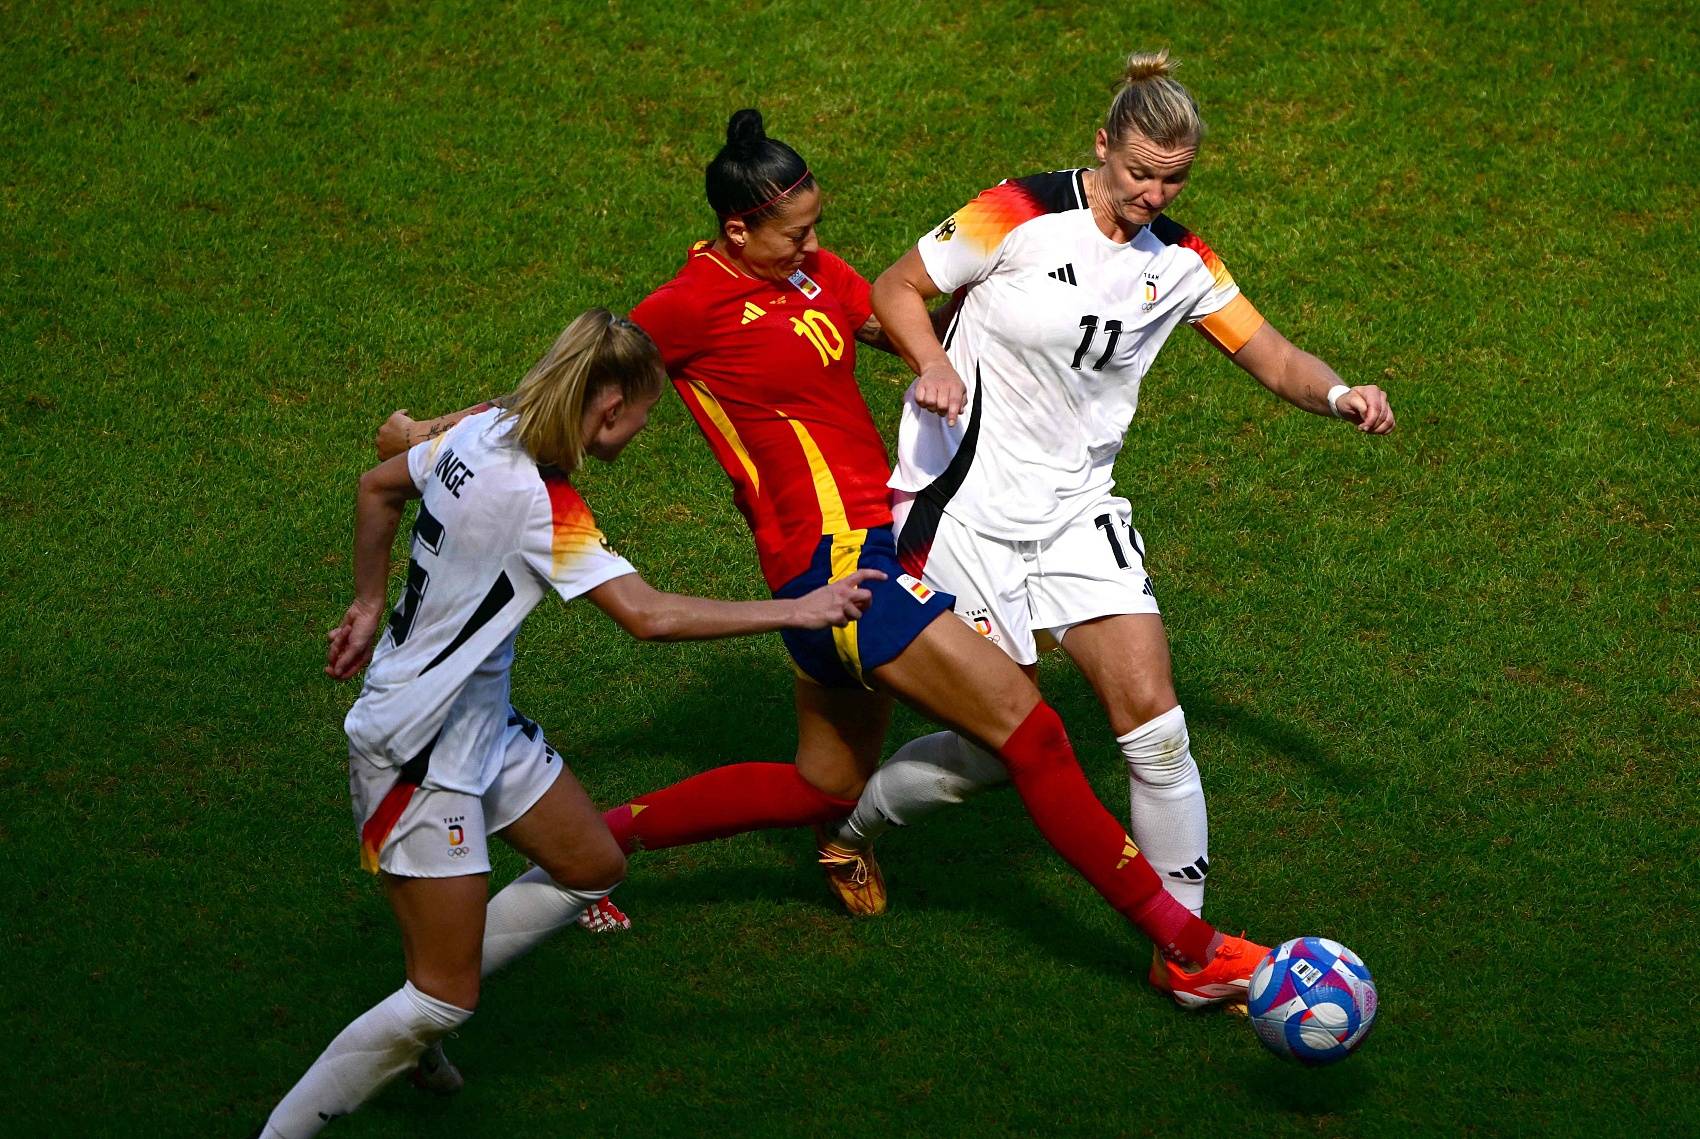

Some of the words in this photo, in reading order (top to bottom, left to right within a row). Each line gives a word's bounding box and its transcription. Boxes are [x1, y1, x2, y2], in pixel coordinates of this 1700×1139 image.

[1144, 272, 1159, 280] TEAM
[789, 309, 844, 367] 10
[1071, 315, 1123, 371] 11
[435, 448, 475, 499] INGE
[966, 608, 987, 616] TEAM
